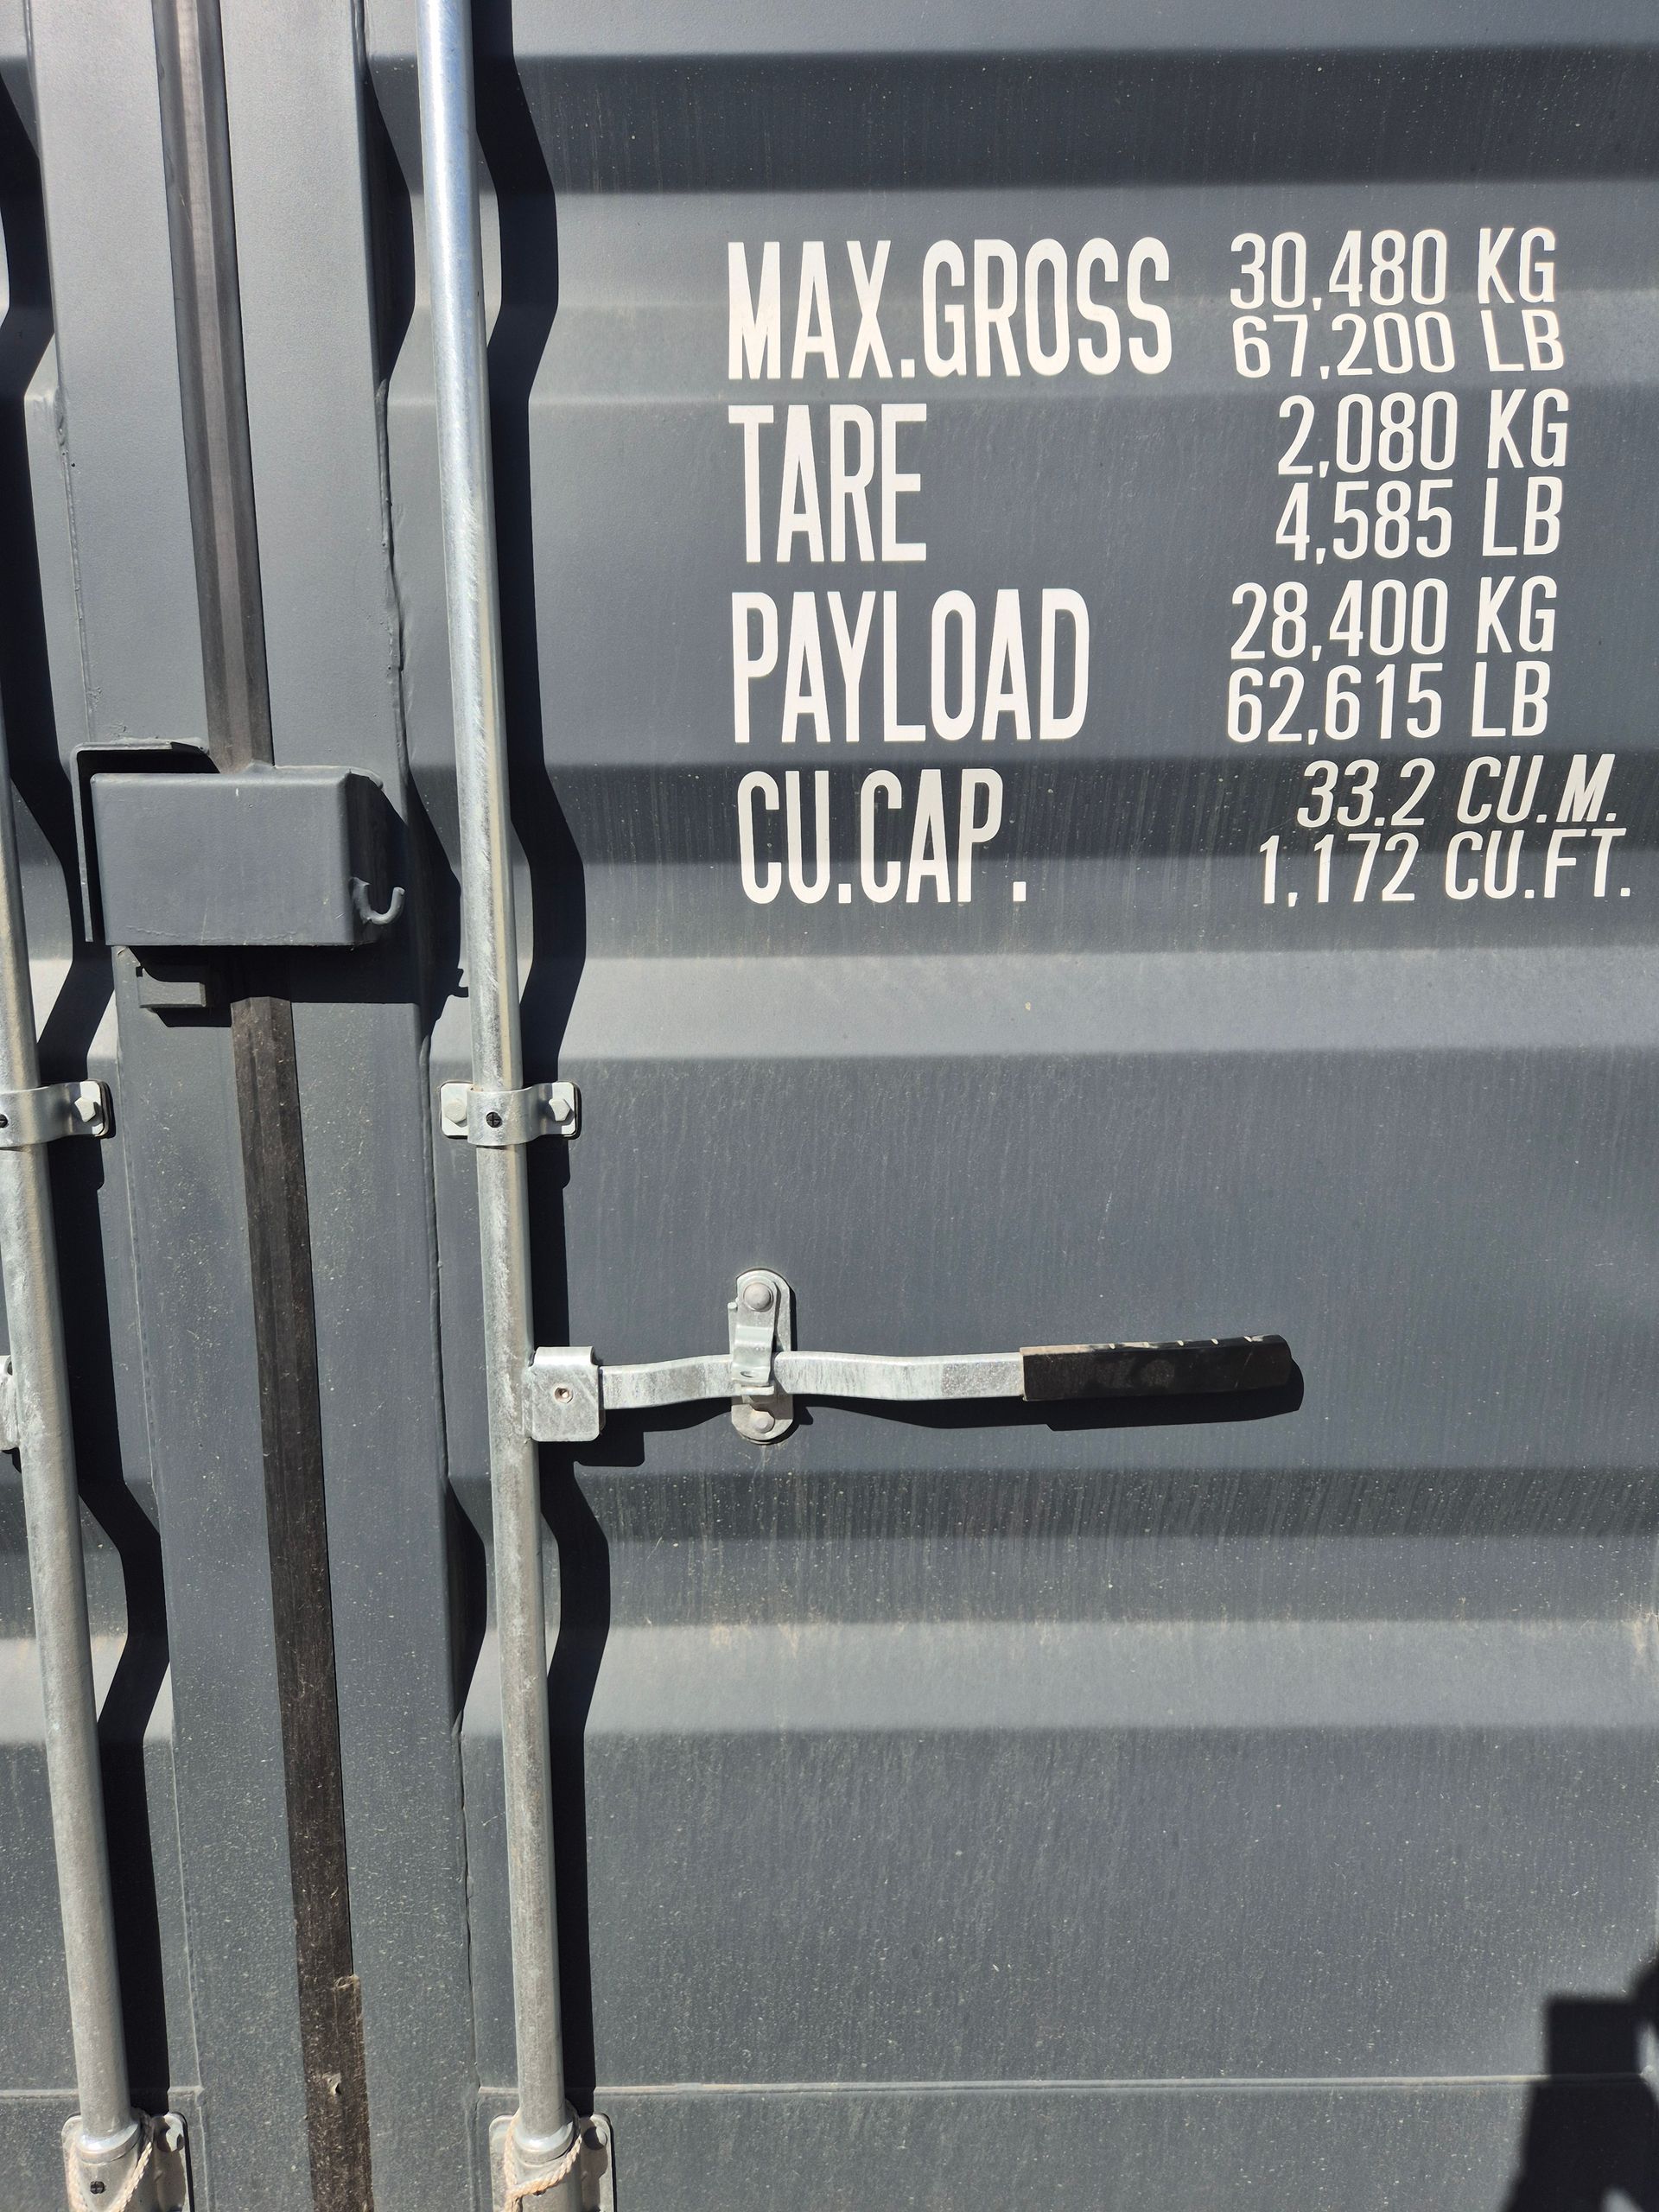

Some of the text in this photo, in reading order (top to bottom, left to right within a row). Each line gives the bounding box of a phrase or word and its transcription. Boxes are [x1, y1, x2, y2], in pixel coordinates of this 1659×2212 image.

[728, 237, 1173, 380] MAX.GROSS
[1230, 227, 1556, 311] 30,480 KG
[1232, 309, 1565, 380] 67,200 LB
[1278, 388, 1569, 479] 2,080 KG
[728, 404, 927, 563] TARE
[1275, 476, 1563, 565] 4,585 LB
[1230, 575, 1557, 662] 28,400 KG
[732, 588, 1090, 743] PAYLOAD
[1227, 660, 1551, 745] 62,615 LB
[1297, 753, 1618, 828] 33.2 CU.M.
[1260, 827, 1630, 907] 1,172 CU.FT.
